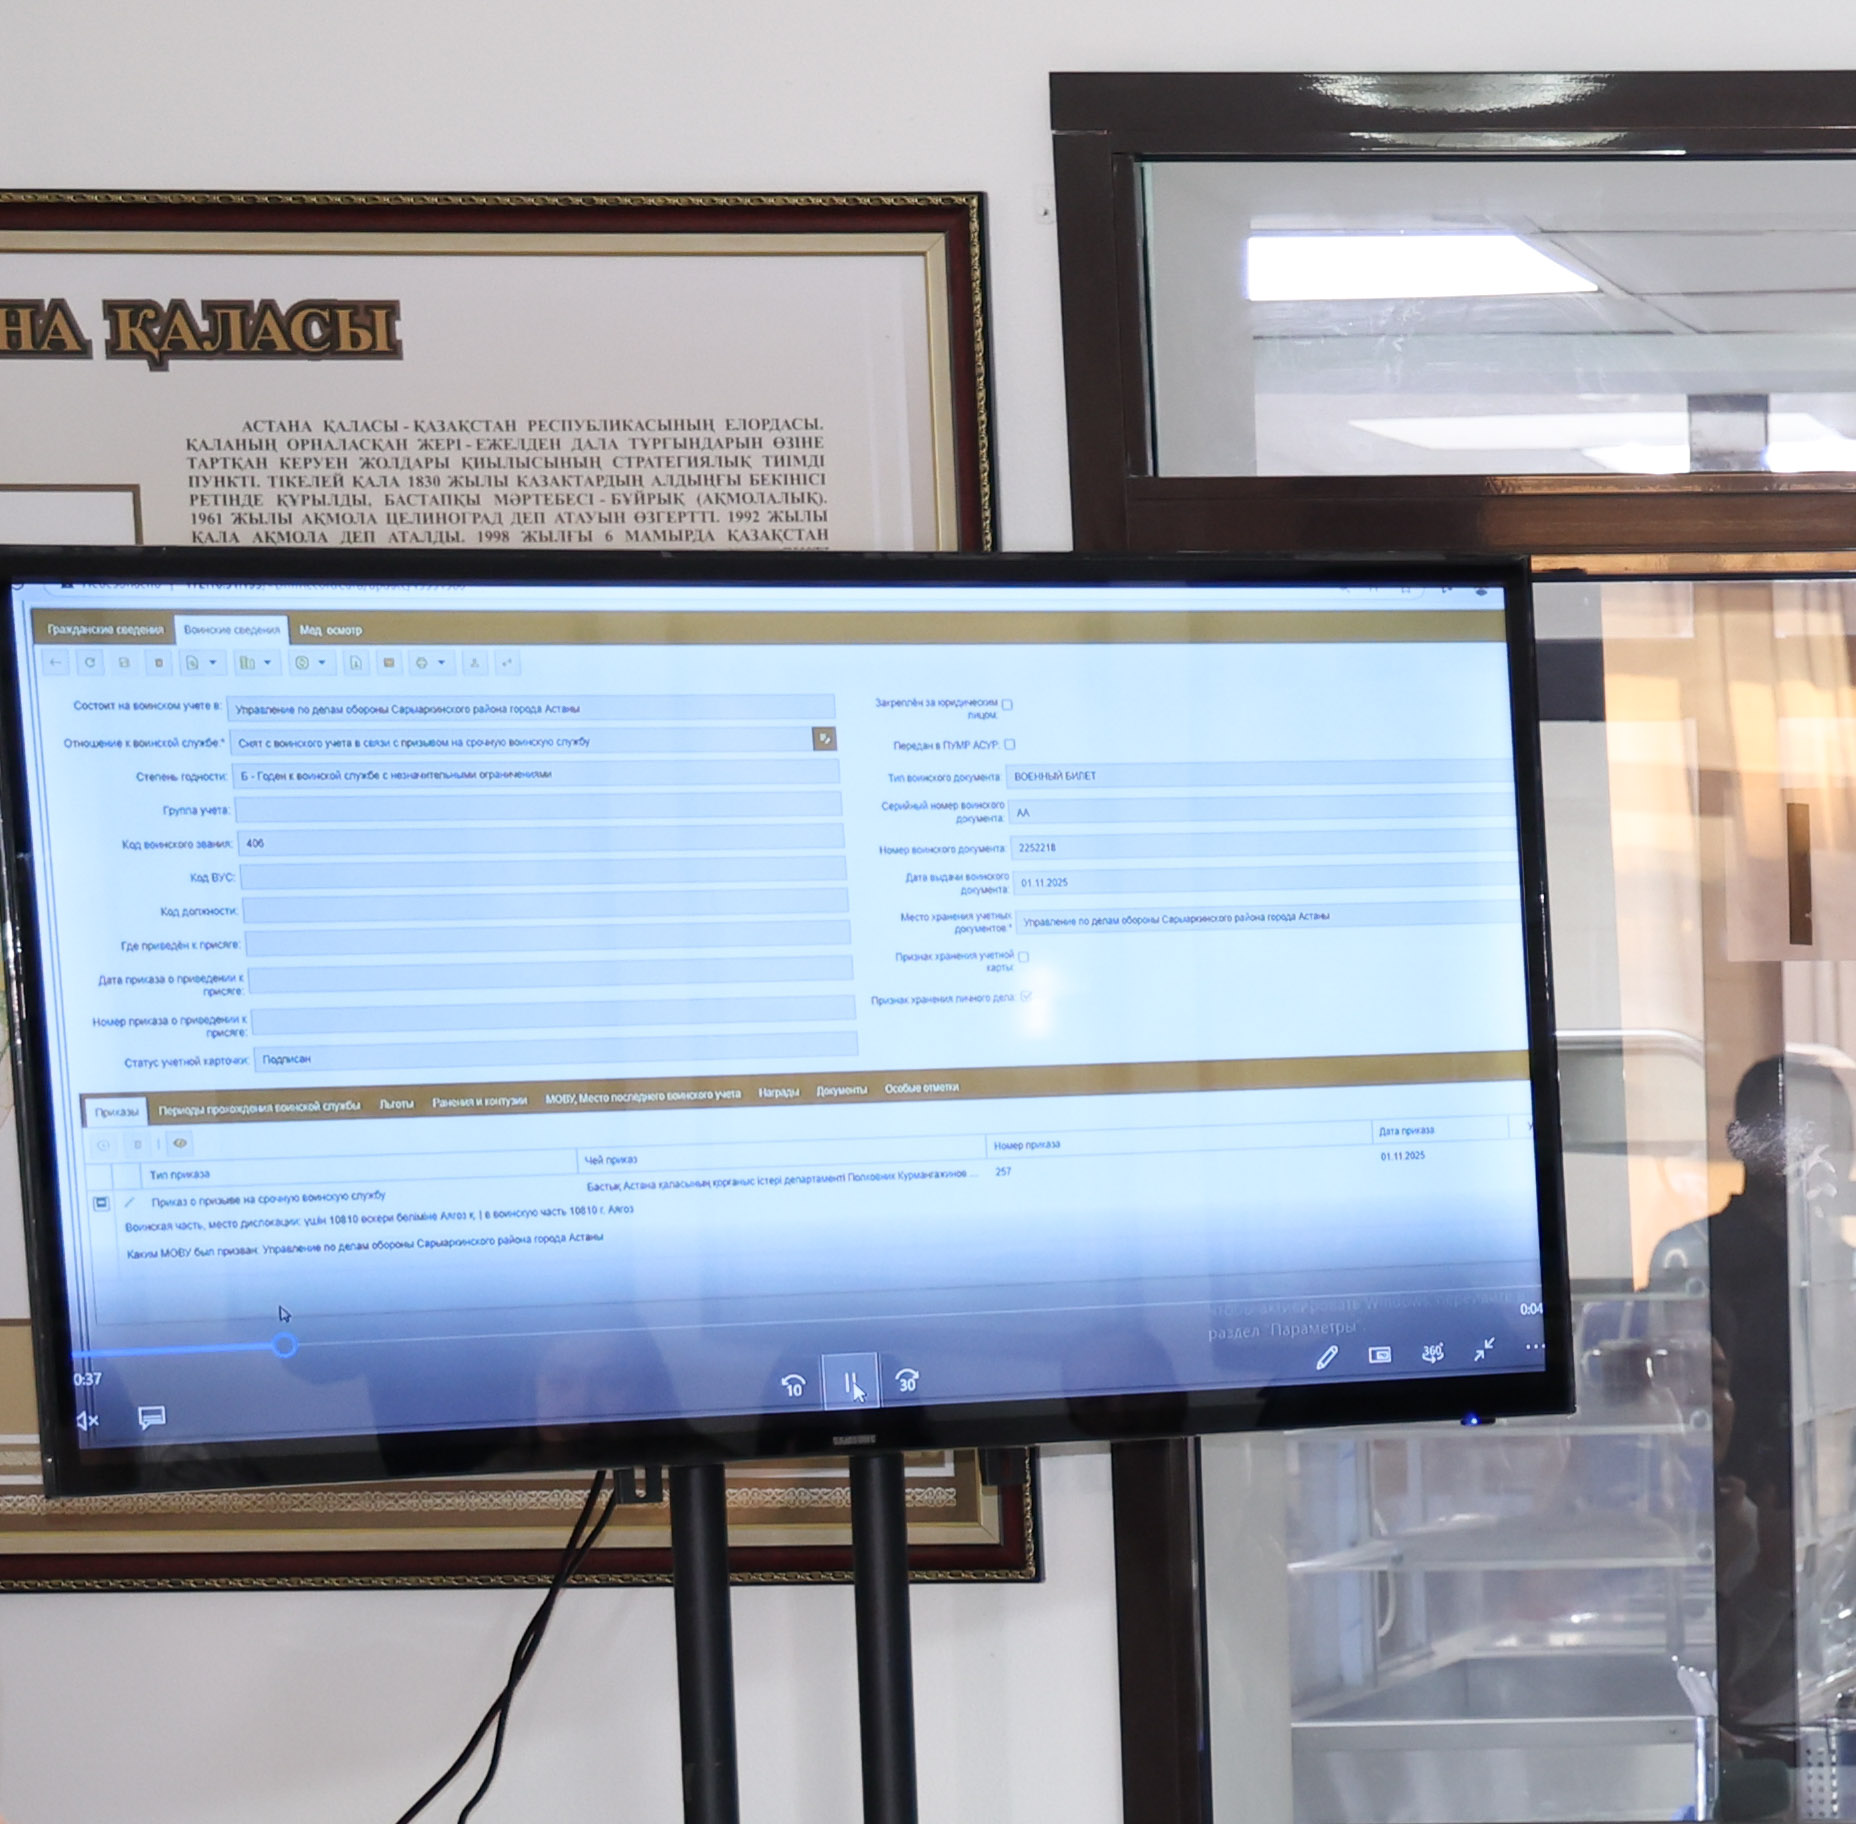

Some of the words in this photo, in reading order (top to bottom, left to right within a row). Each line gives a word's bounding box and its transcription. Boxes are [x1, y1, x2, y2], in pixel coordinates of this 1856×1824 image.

[109, 303, 397, 367] ҚАЛАСЫ
[243, 420, 312, 432] АСТАНА
[324, 420, 398, 433] ҚАЛАСЫ
[414, 420, 516, 433] ҚАЗАҚСТАН
[528, 419, 715, 433] РЕСПУБЛИКАСЫНЫҢ
[726, 418, 823, 432] ЕЛОРДАСЫ.
[187, 457, 267, 471] ТАРТҚАН
[280, 457, 347, 469] КЕРУЕН
[359, 457, 449, 470] ЖОЛДАРЫ
[613, 456, 752, 469] СТРАТЕГИЯЛЫҚ
[762, 455, 824, 468] ТИІМДІ
[189, 476, 260, 488] ПУНКТІ.
[268, 474, 343, 488] ТІКЕЛЕЙ
[353, 476, 399, 488] ҚАЛА
[409, 476, 440, 487] 1830
[448, 475, 508, 487] ЖЫЛЫ
[750, 473, 825, 486] БЕКІНІСІ
[192, 513, 221, 525] 1961
[231, 512, 292, 524] ЖЫЛЫ
[302, 512, 377, 526] АҚМОЛА
[387, 512, 503, 526] ЦЕЛИНОГРАД
[511, 512, 545, 525] ДЕП
[555, 512, 625, 524] АТАУЫН
[634, 511, 719, 523] ӨЗГЕРТТІ.
[729, 511, 759, 522] 1992
[768, 510, 828, 522] ЖЫЛЫ
[192, 531, 240, 545] ҚАЛА
[253, 531, 328, 545] АҚМОЛА
[340, 531, 374, 544] ДЕП
[389, 531, 464, 544] АТАЛДЫ.
[478, 531, 509, 543] 1998
[605, 531, 613, 542] 6
[626, 530, 715, 543] МАМЫРДА
[728, 529, 828, 543] ҚАЗАҚСТАН
